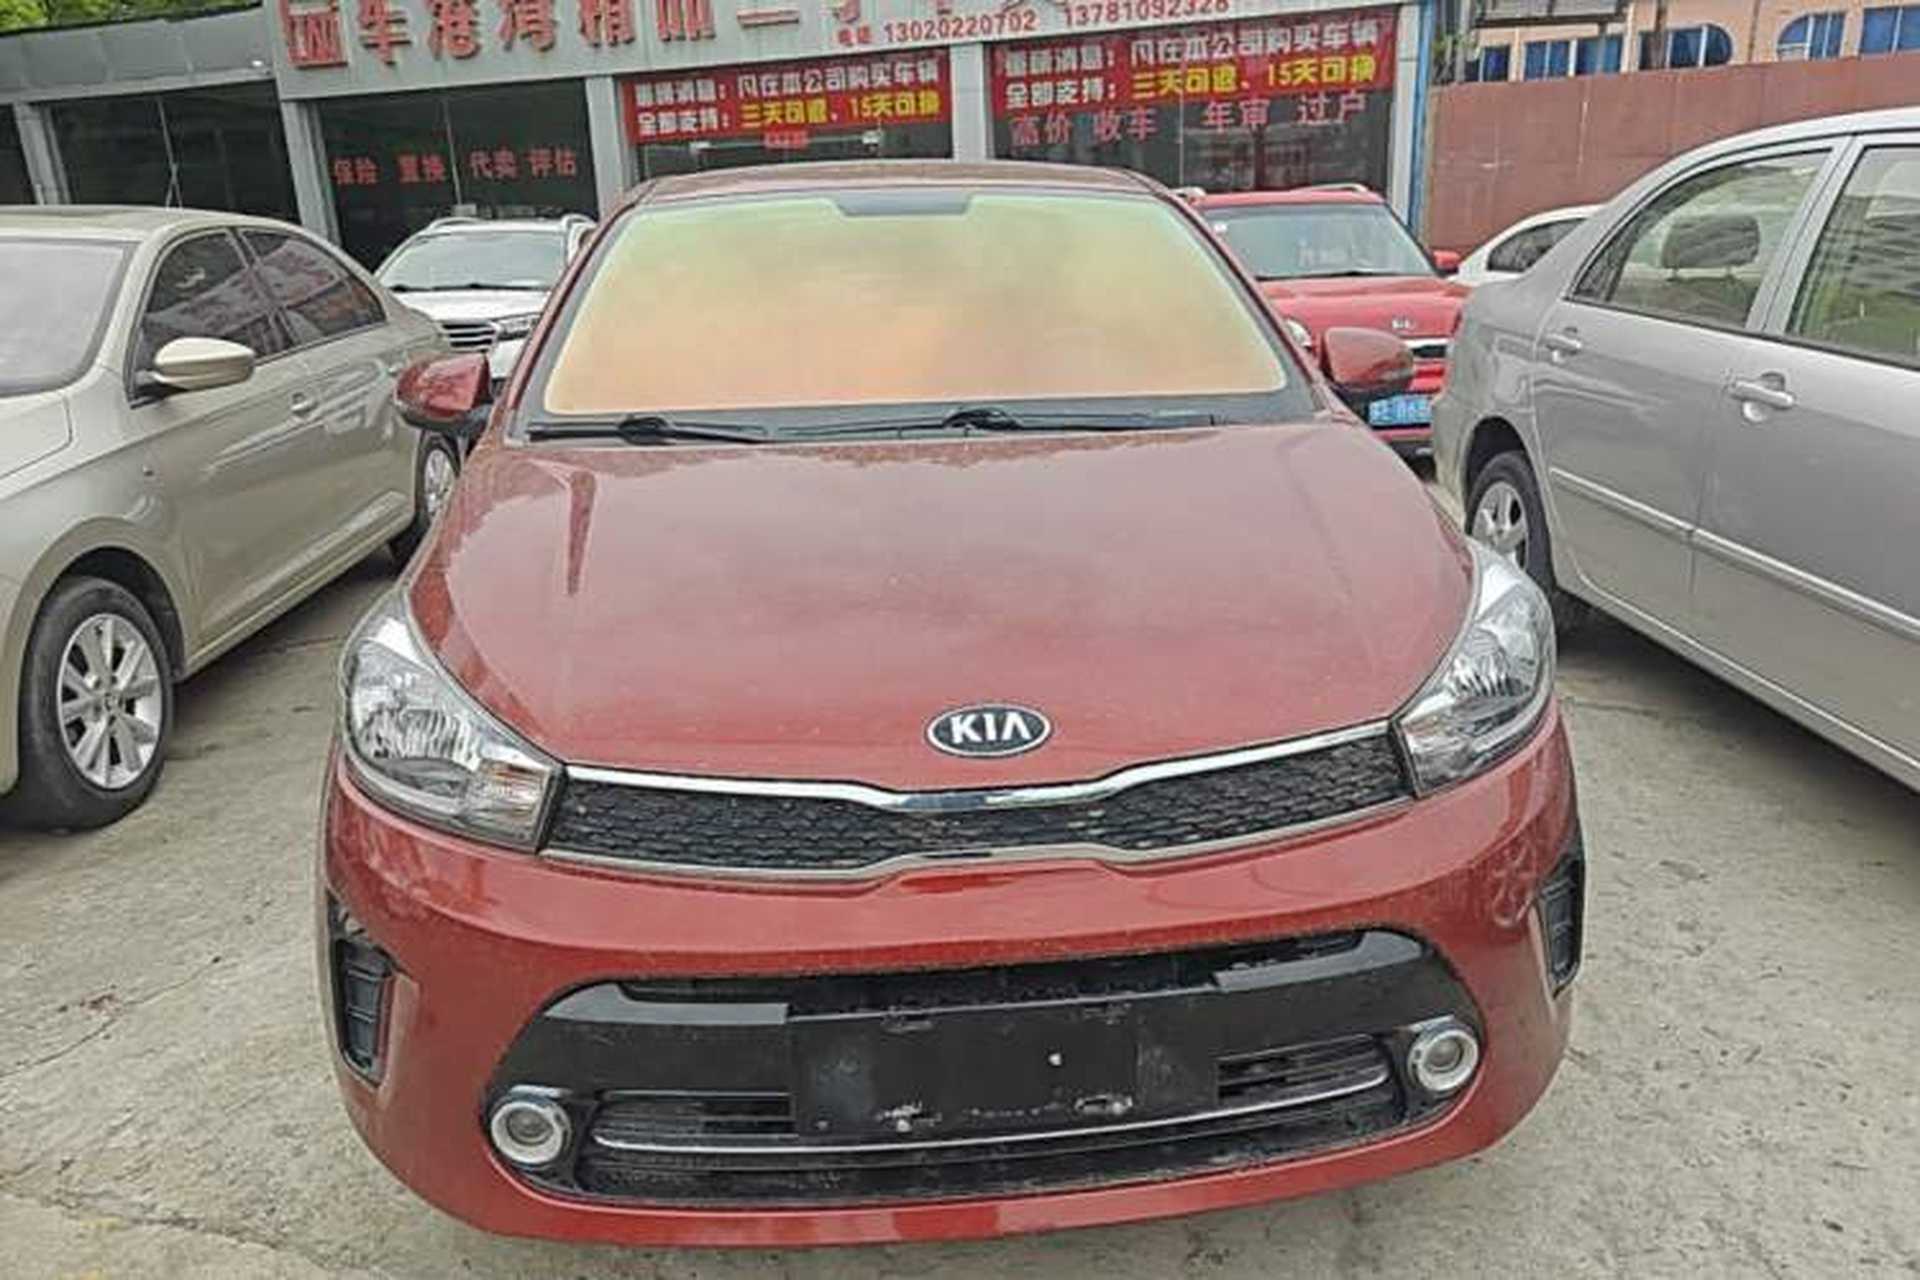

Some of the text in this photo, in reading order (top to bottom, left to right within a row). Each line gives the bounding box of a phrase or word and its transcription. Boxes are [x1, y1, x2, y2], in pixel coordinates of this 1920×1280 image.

[884, 9, 1037, 43] 13020220702
[1297, 89, 1367, 127] 过户
[951, 711, 1033, 744] KIA
